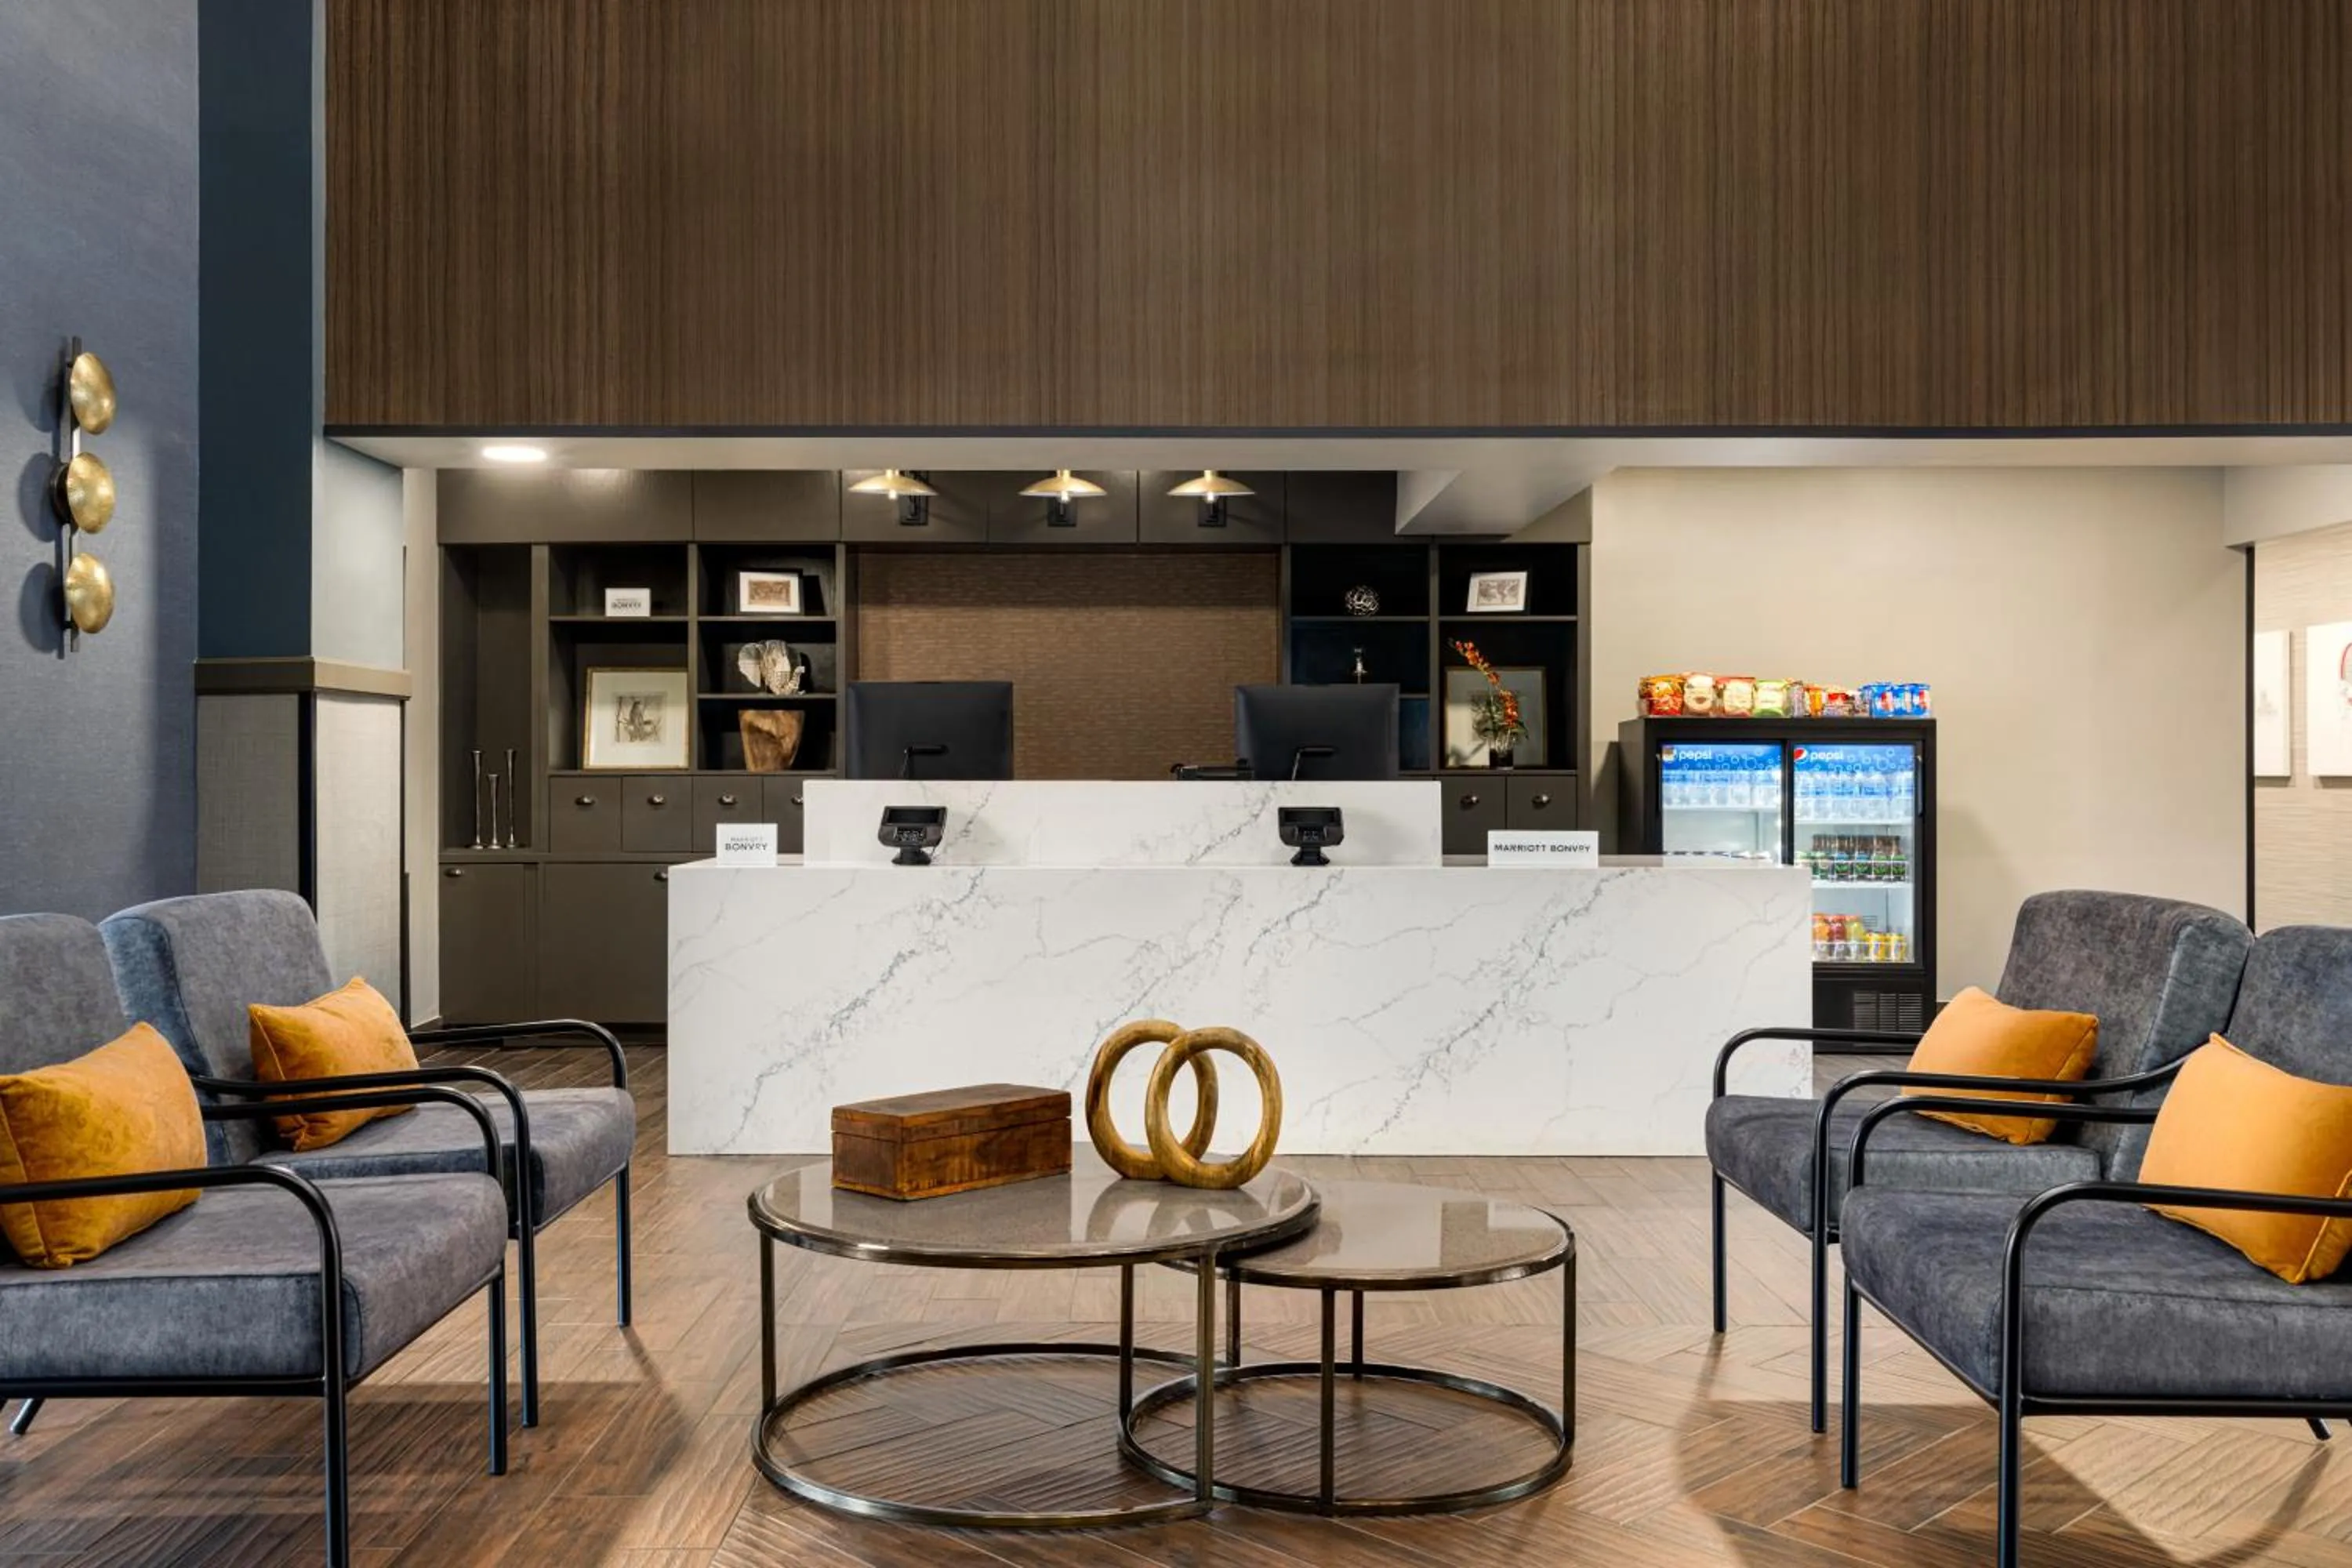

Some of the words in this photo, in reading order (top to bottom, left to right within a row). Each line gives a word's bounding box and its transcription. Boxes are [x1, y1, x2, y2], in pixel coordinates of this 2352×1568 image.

[1679, 750, 1712, 761] pepsi
[1810, 750, 1845, 762] pepsi
[1494, 844, 1546, 852] MARRIOTT
